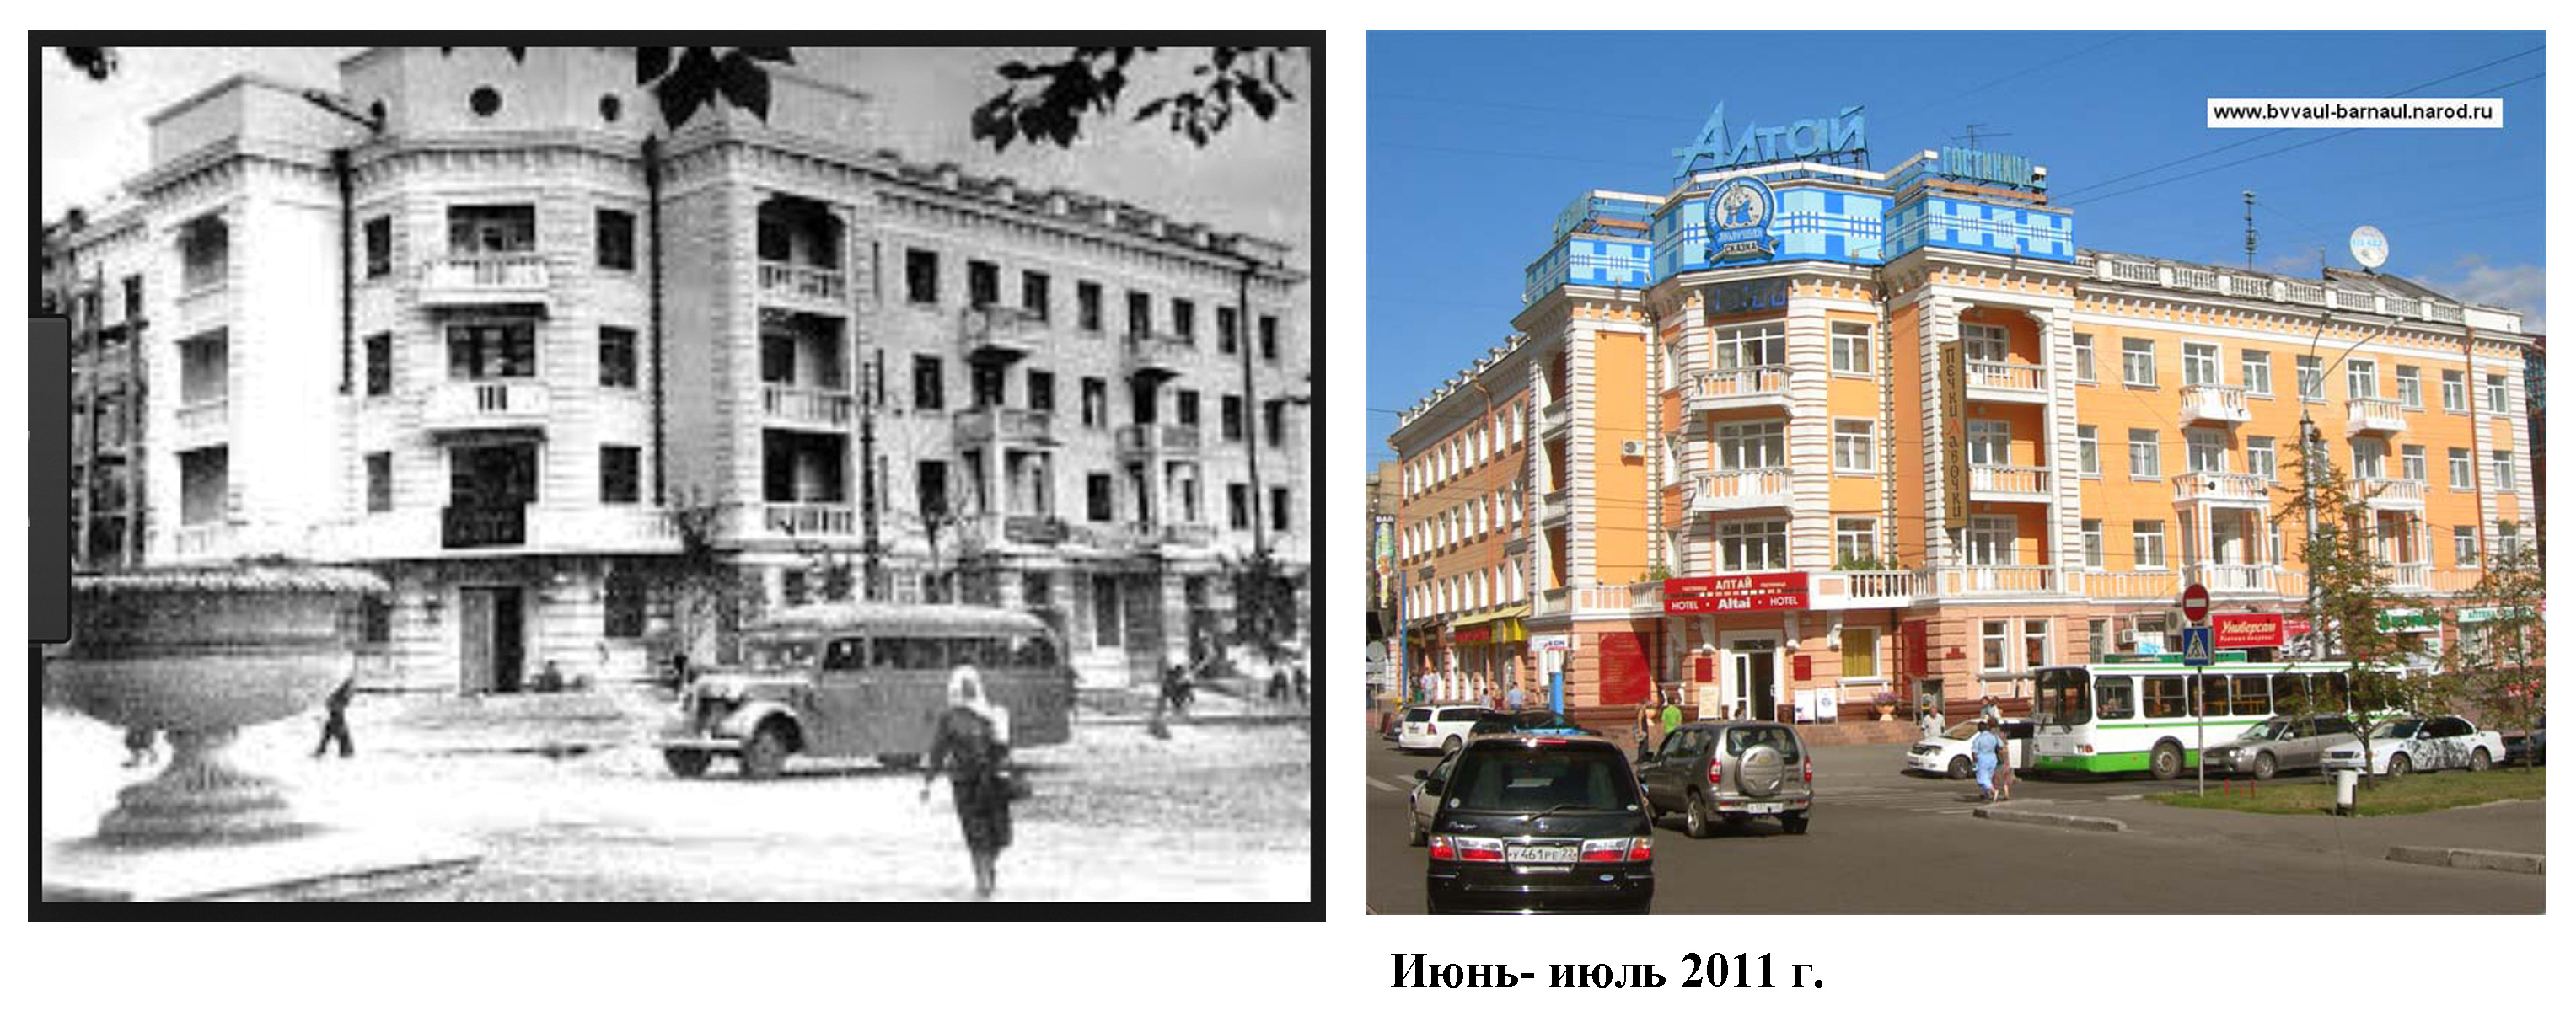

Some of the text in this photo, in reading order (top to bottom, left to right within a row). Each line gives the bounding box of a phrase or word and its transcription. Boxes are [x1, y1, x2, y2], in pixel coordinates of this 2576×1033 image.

[1671, 597, 1798, 610] HOTEL Altai HOTEL
